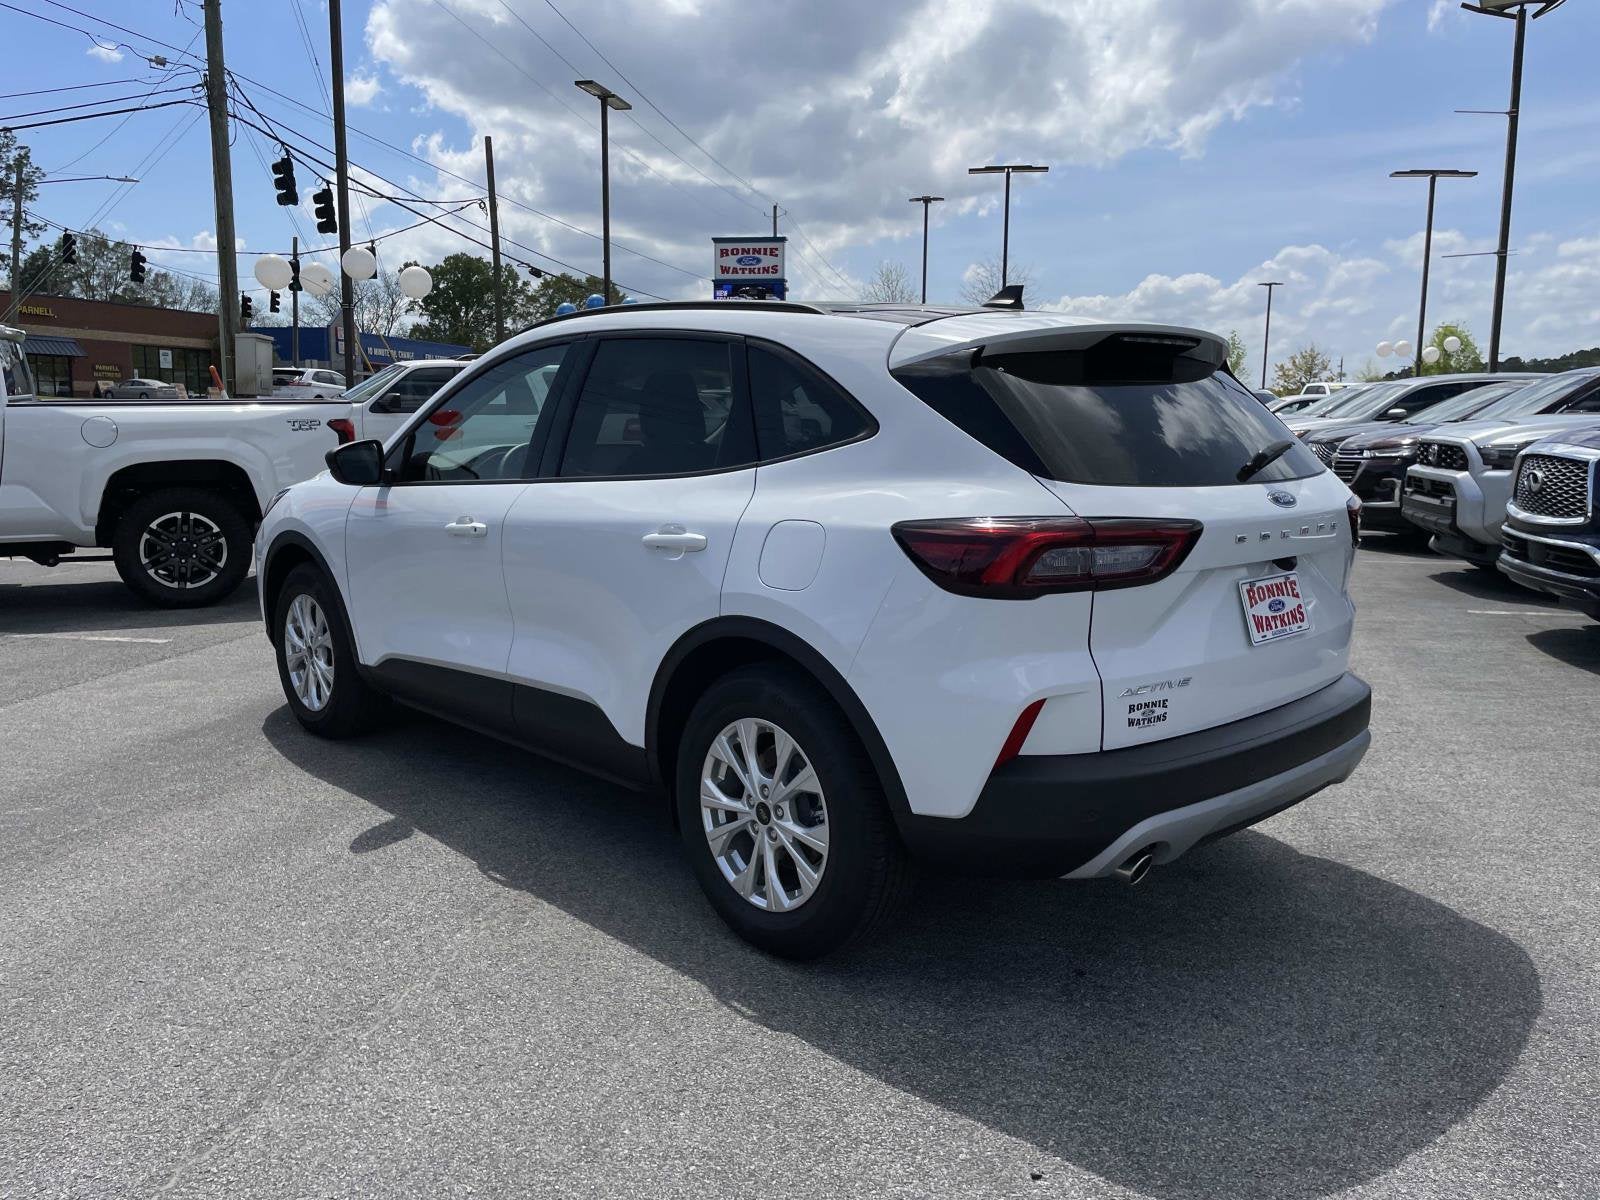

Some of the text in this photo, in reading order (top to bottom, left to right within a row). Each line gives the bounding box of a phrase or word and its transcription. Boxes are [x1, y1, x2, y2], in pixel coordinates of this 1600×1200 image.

[720, 247, 779, 258] RONNIE
[740, 257, 758, 265] Ford
[720, 265, 779, 275] WATKINS
[17, 305, 55, 317] PARNELL
[95, 364, 120, 372] PARNELL
[287, 419, 321, 428] TRD
[1235, 521, 1337, 544] ESCAPE
[1246, 579, 1300, 608] RONNIE
[1269, 600, 1285, 612] Ford
[1252, 603, 1305, 634] WATKINS
[1117, 677, 1192, 698] ACTIVE
[1128, 699, 1169, 714] RONNIE
[1127, 712, 1168, 727] WATKINS
